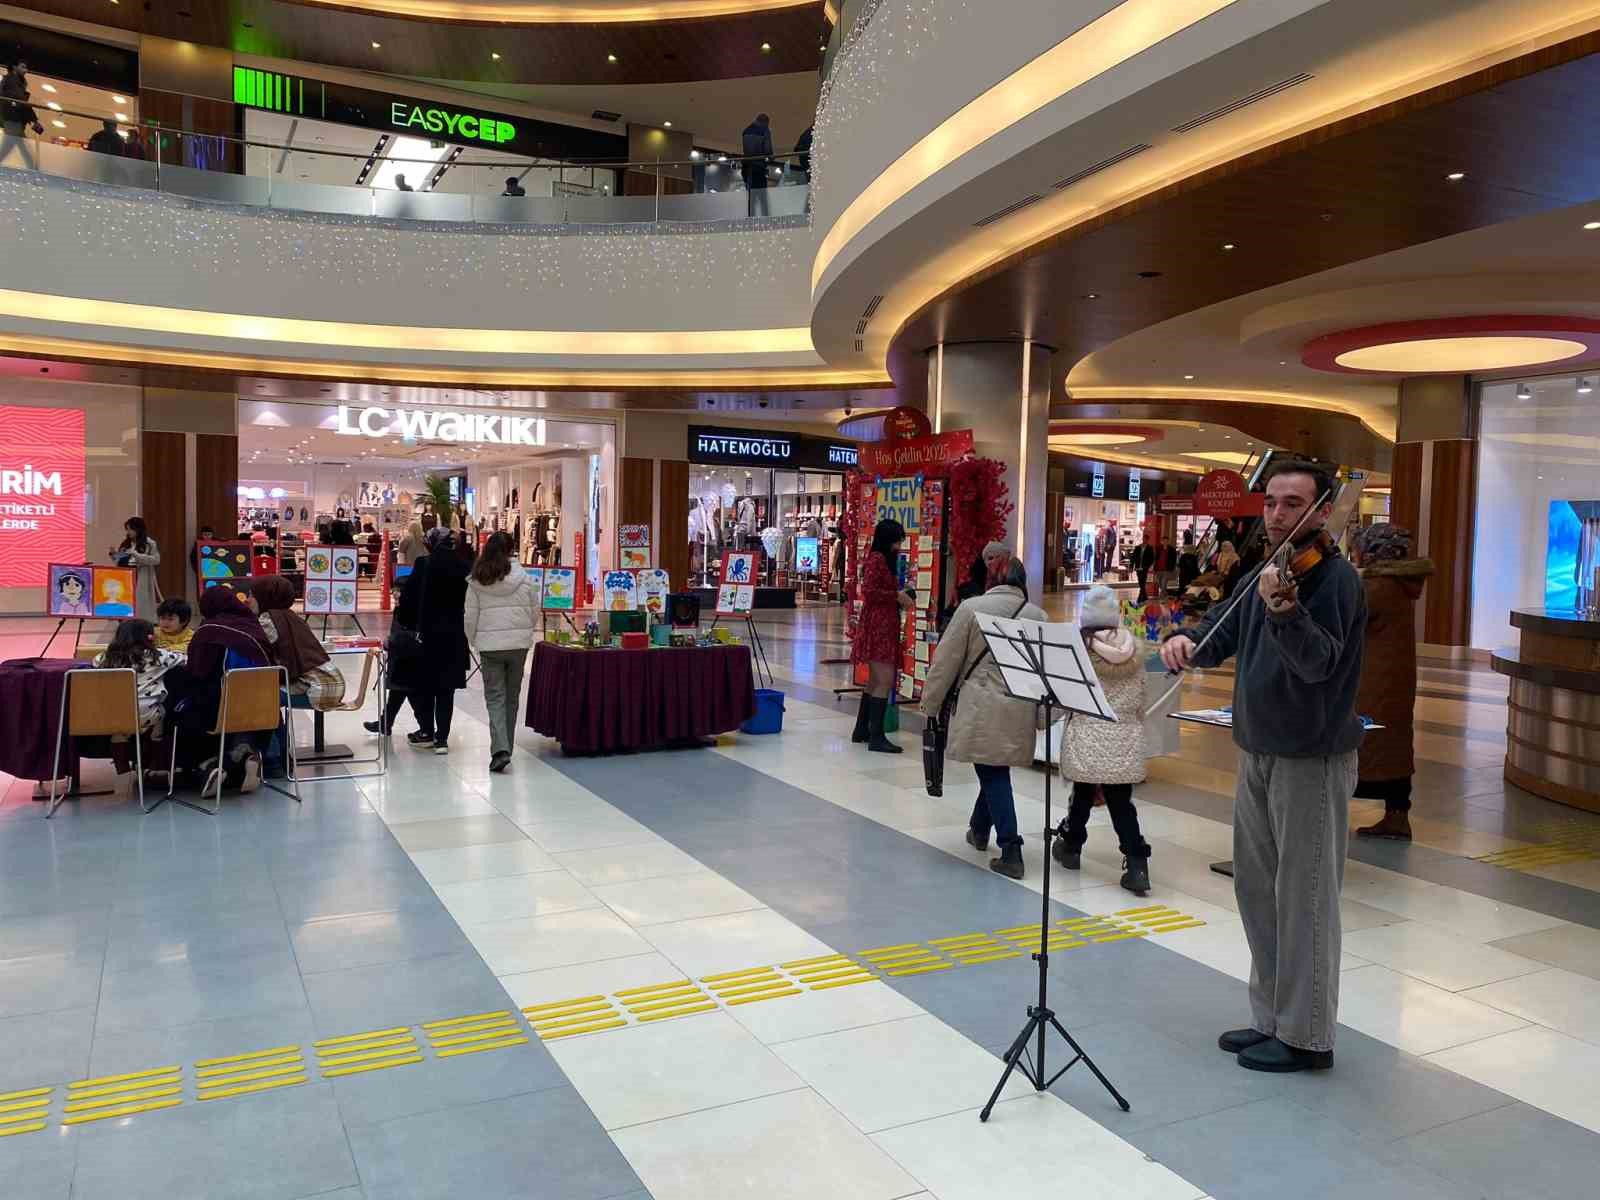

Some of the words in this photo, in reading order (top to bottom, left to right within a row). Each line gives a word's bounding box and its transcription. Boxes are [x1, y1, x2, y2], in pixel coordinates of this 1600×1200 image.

[391, 102, 516, 143] EASYCEP
[334, 405, 389, 437] LC
[697, 438, 791, 458] HATEMOĞLU
[0, 464, 63, 496] RİM
